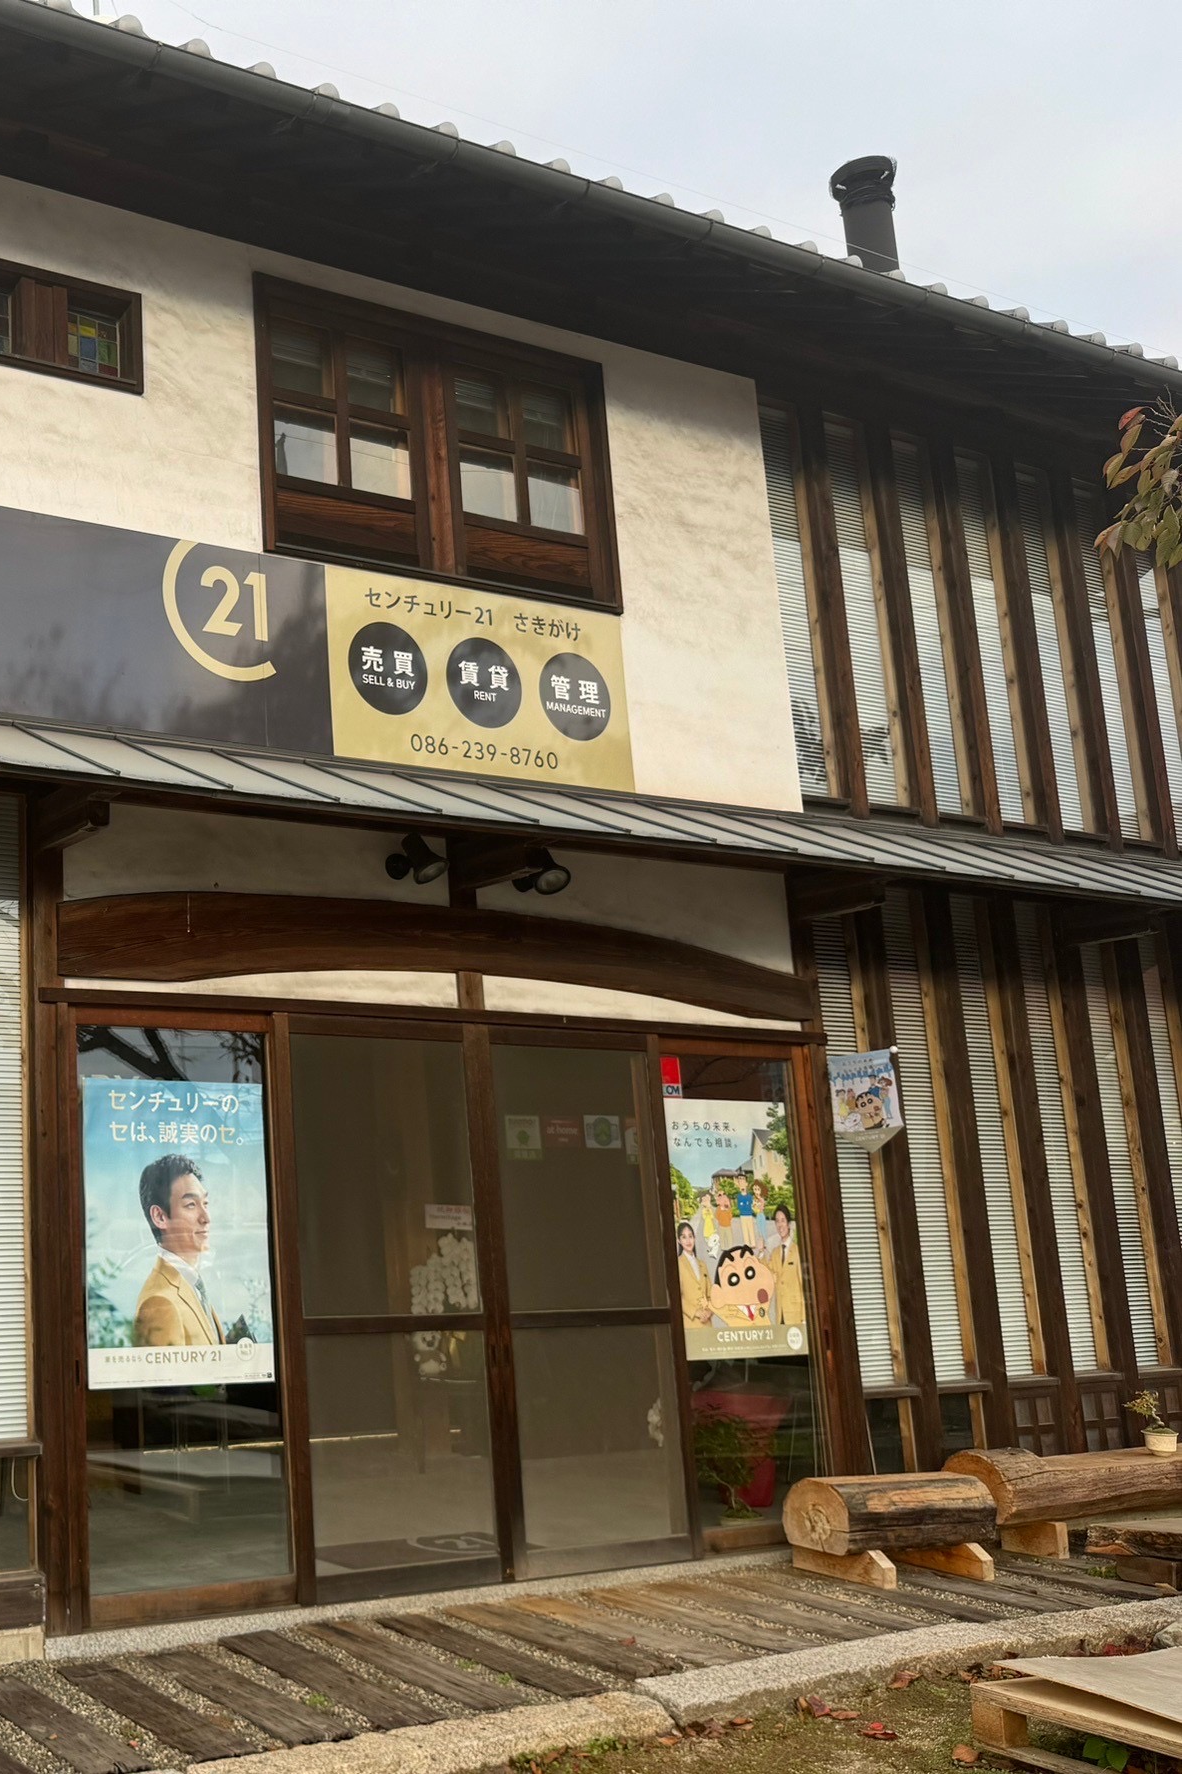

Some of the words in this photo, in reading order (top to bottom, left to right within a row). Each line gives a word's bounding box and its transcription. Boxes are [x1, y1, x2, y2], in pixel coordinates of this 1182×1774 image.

[200, 565, 268, 642] 21
[365, 587, 493, 626] センチュリー21
[513, 612, 581, 642] さきがけ
[361, 646, 415, 677] 売買
[362, 673, 385, 686] SELL
[387, 677, 394, 687] &
[396, 679, 415, 690] BUY
[550, 675, 600, 705] 管理
[473, 690, 497, 702] RENT
[546, 701, 606, 719] MANAGEMENT
[410, 733, 558, 770] 086-239-8760
[108, 1089, 239, 1114] センチュリーの
[109, 1121, 244, 1146] セは、誠実のセ。
[716, 1329, 764, 1343] CENTURY
[765, 1329, 774, 1340] 21
[145, 1351, 207, 1364] CENTURY
[211, 1350, 222, 1362] 21
